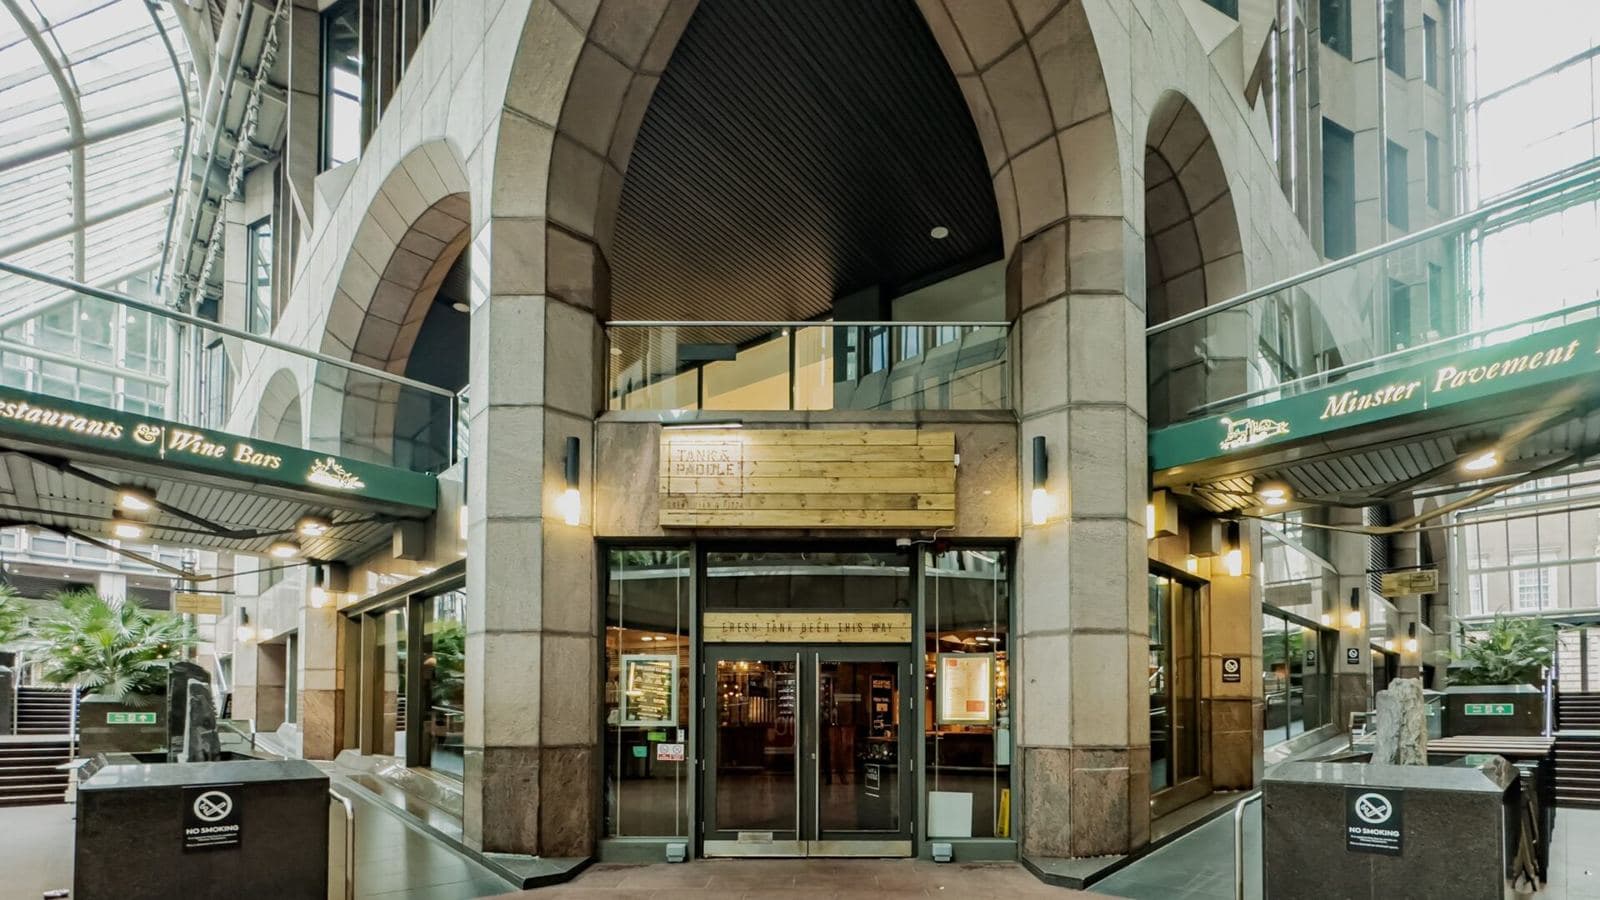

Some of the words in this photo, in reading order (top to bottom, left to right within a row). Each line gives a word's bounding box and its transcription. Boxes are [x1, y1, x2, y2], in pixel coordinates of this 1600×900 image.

[1320, 381, 1421, 420] Minster
[1431, 339, 1580, 393] Pavement
[133, 423, 161, 445] &
[168, 428, 227, 458] Wine
[233, 442, 282, 469] Bars
[766, 622, 794, 634] TANK
[838, 622, 864, 634] THIS
[871, 622, 893, 634] WAY
[201, 825, 239, 833] SMOKING
[1362, 828, 1400, 837] SMOKING
